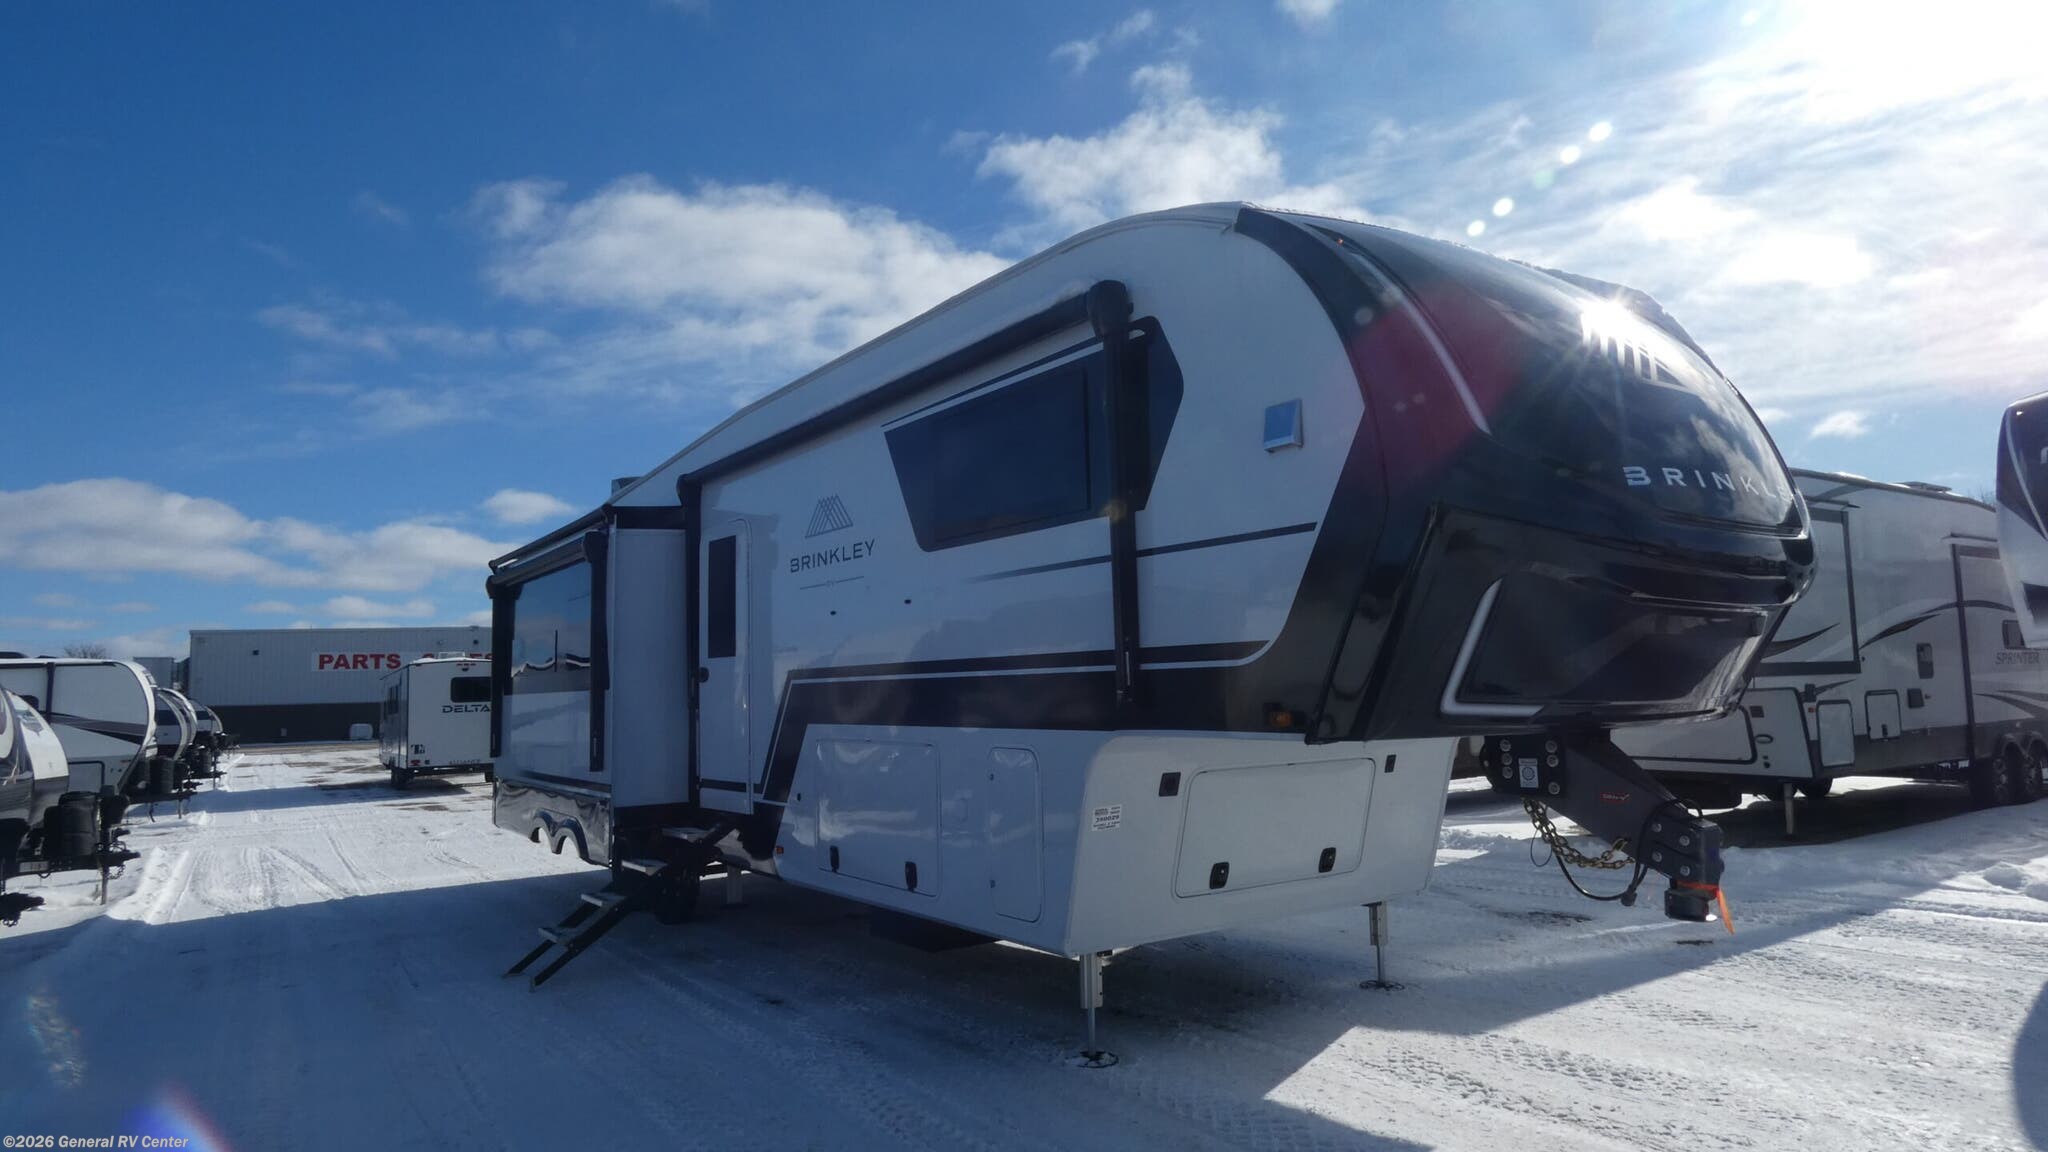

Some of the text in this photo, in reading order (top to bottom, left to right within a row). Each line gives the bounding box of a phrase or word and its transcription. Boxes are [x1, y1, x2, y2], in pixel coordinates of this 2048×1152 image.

[1623, 466, 1791, 502] BRINKLE
[789, 538, 875, 574] BRINKLEY
[318, 653, 401, 670] PARTS
[1995, 651, 2040, 665] SPRINTER
[442, 704, 491, 714] DELTA
